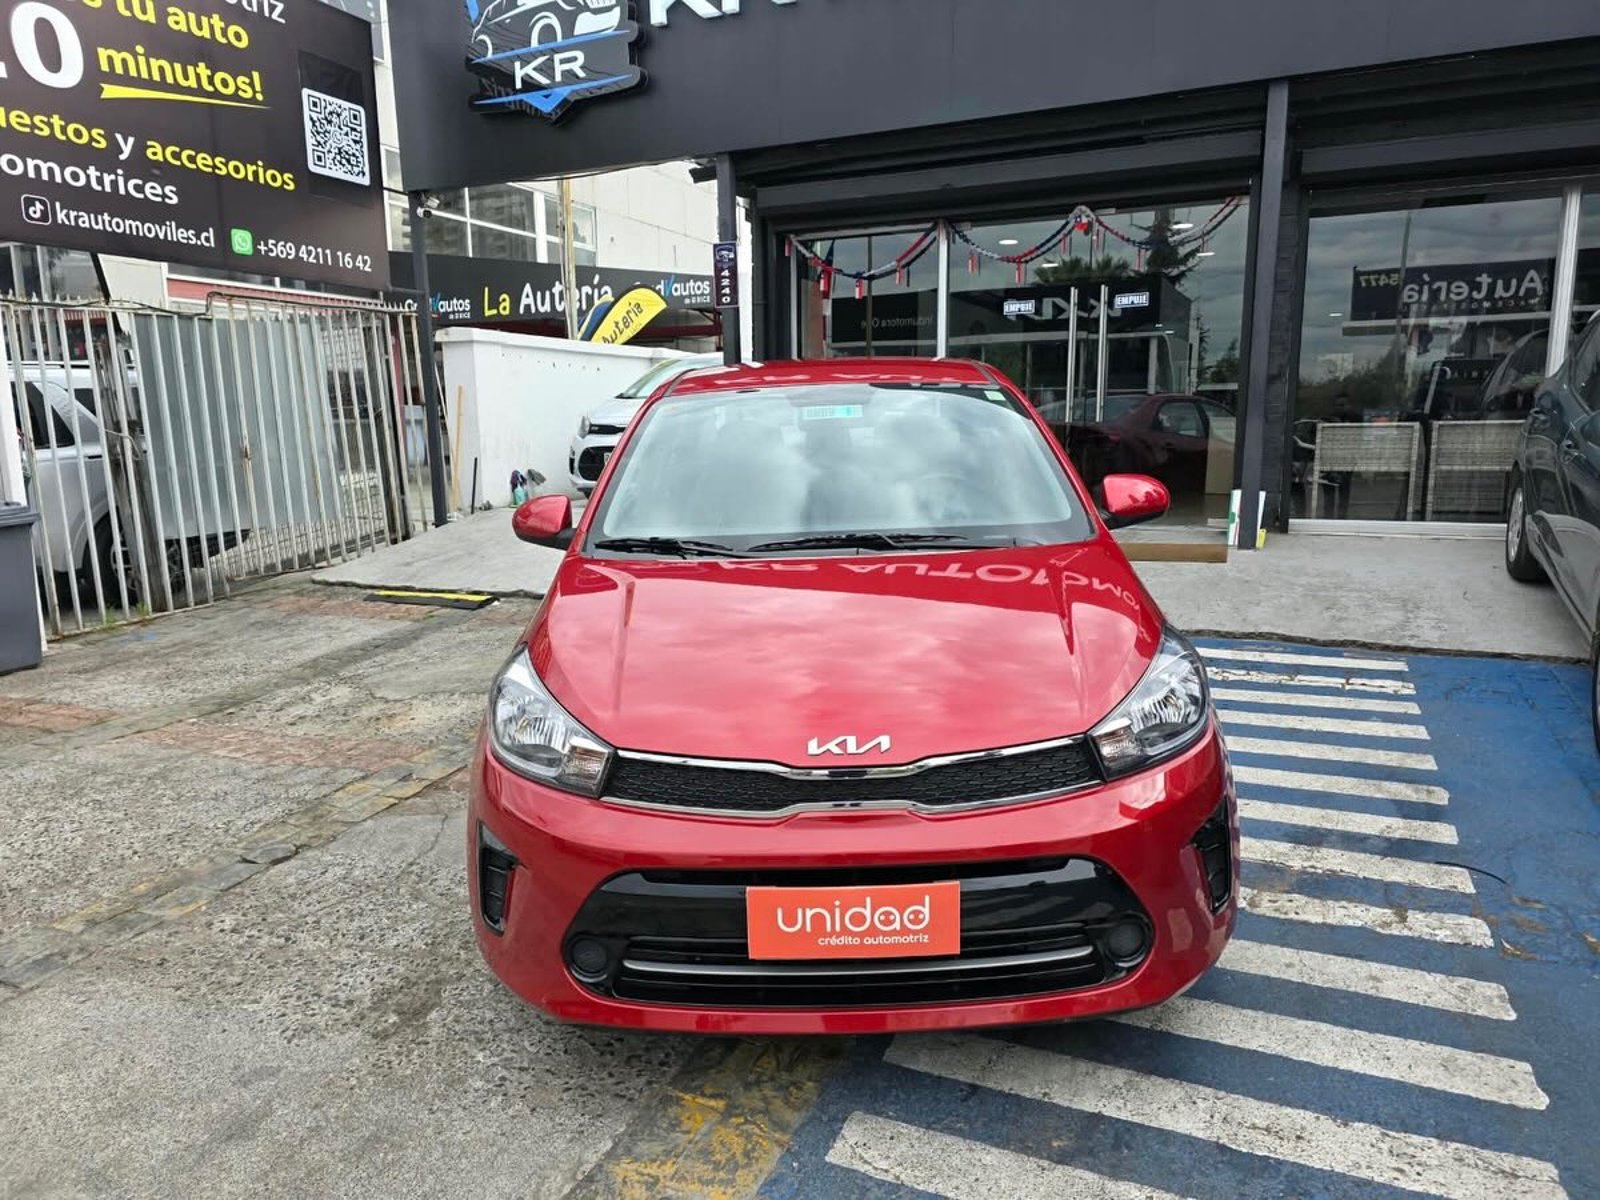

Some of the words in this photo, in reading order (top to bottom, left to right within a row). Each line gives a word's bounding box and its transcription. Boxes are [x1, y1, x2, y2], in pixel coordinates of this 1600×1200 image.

[166, 5, 249, 48] auto
[97, 45, 264, 101] minutos!
[514, 50, 586, 90] KR
[114, 131, 135, 160] y
[146, 139, 296, 191] accesorios
[55, 202, 215, 248] krautomoviles.cl
[257, 240, 296, 260] +569
[299, 245, 332, 266] 4211
[337, 250, 353, 268] 16
[355, 252, 372, 272] 42
[484, 286, 510, 317] La
[720, 269, 731, 304] 4240
[807, 735, 891, 755] KIA
[777, 895, 930, 933] unidad
[818, 935, 860, 946] crédito
[864, 933, 929, 946] automotriz
